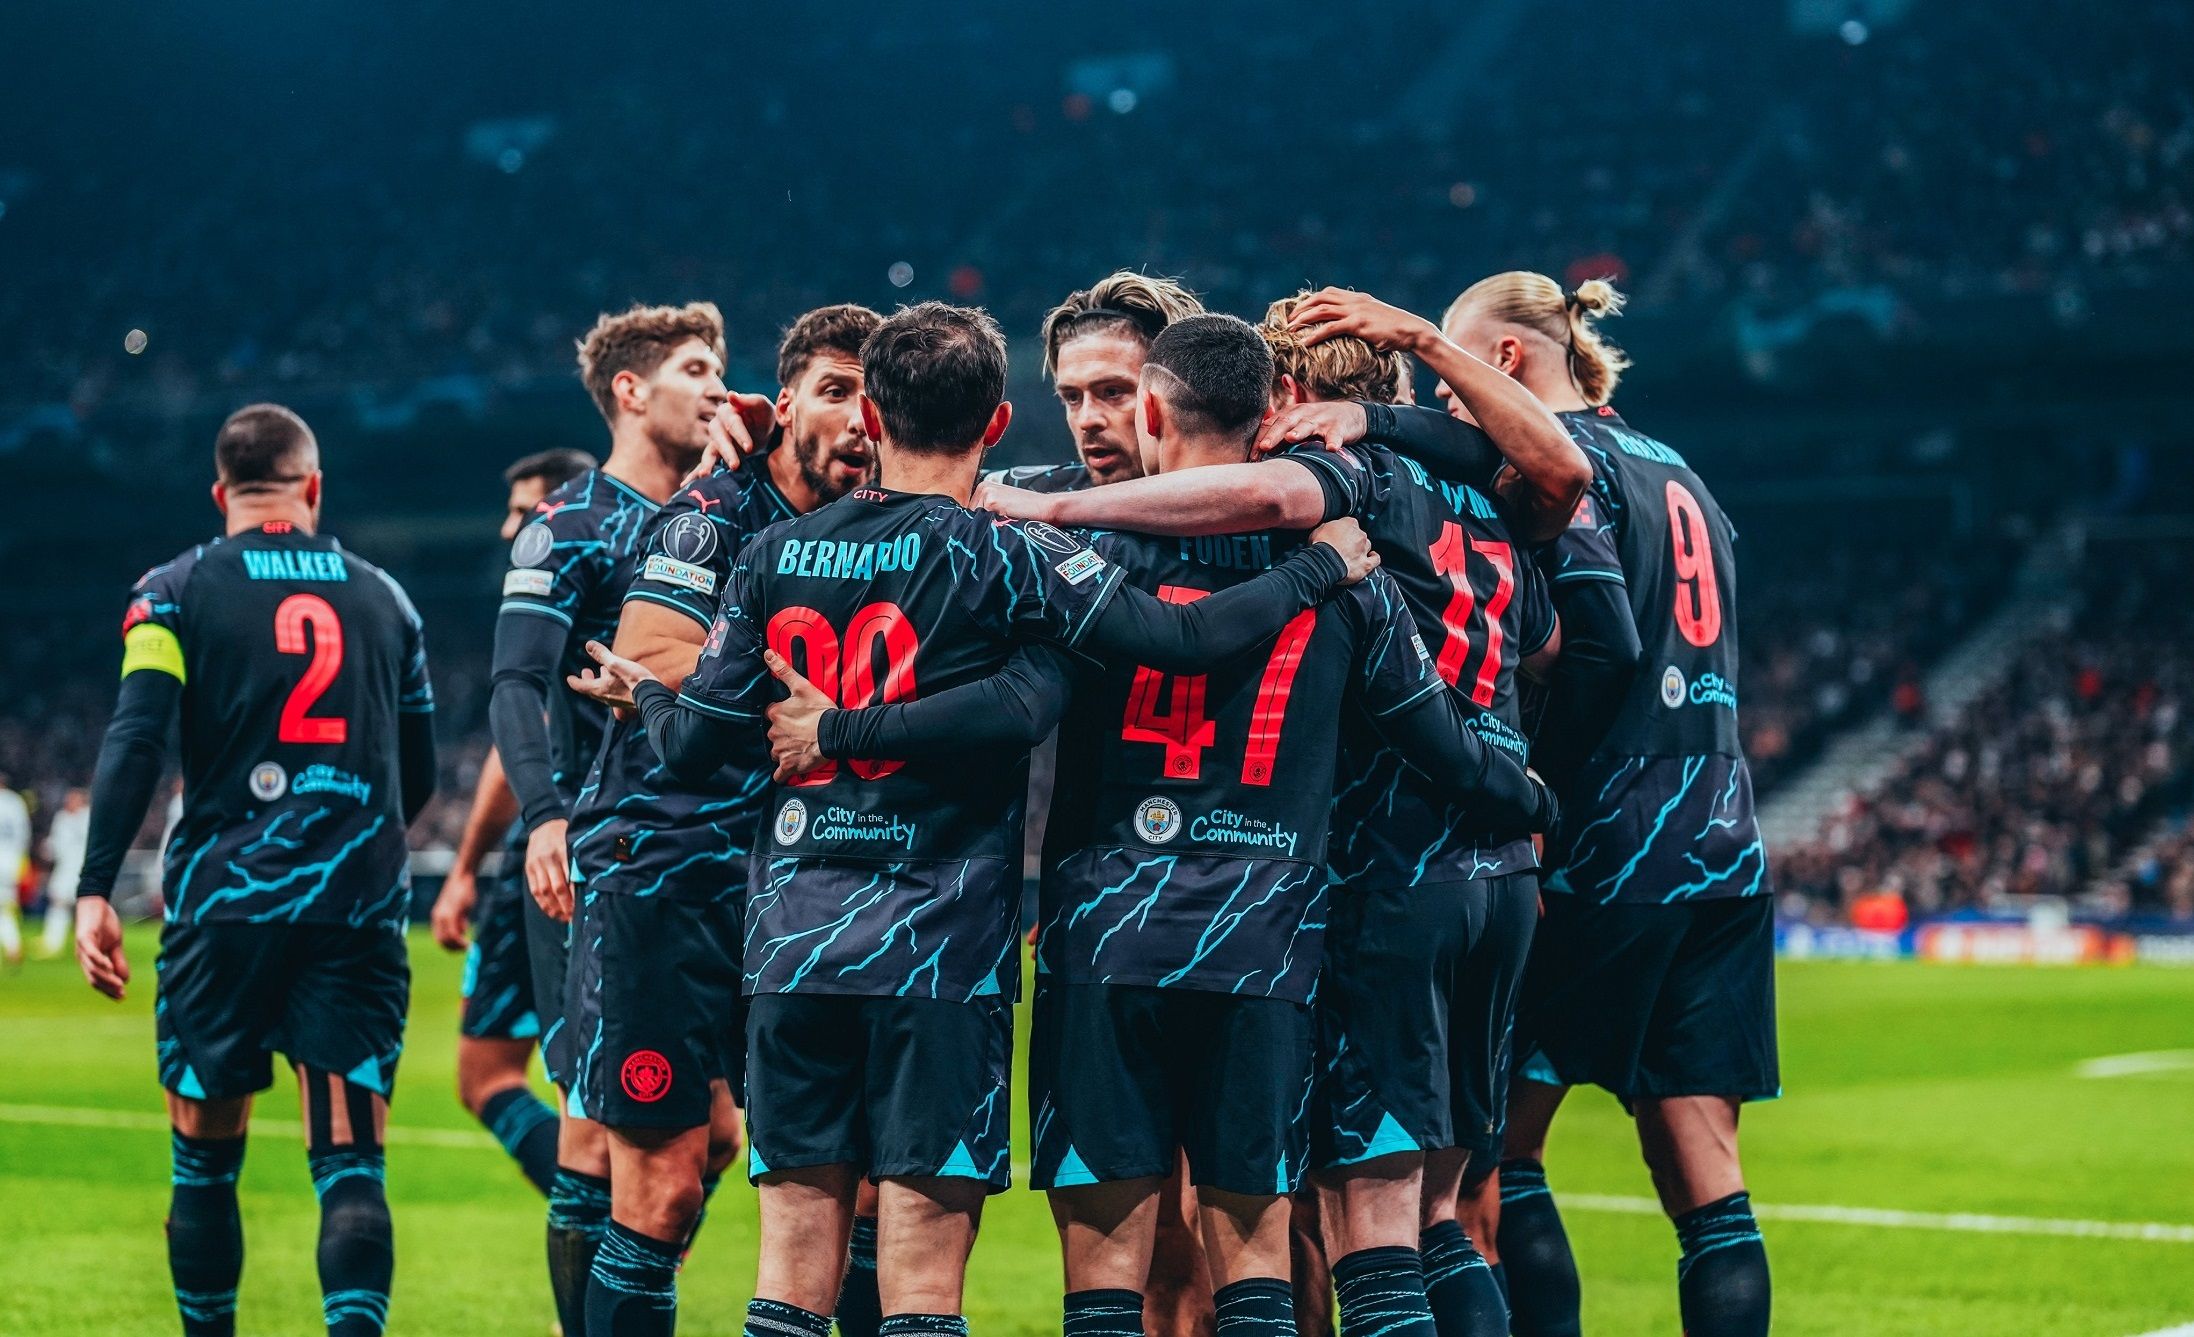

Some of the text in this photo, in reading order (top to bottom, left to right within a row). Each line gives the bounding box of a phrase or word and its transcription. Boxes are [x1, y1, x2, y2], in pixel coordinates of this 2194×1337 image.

[853, 490, 889, 503] CITY
[242, 550, 348, 582] WALKER
[648, 562, 713, 587] FOUNDATION
[1665, 479, 1722, 648] 9
[1428, 520, 1515, 708] 17
[274, 592, 348, 744] 2
[1121, 584, 1318, 787] 47
[1480, 711, 1501, 733] City
[827, 806, 884, 825] City in the
[1139, 798, 1179, 816] MANCHESTER
[1210, 809, 1267, 829] City in the
[811, 814, 916, 850] Community
[1190, 815, 1298, 857] Community
